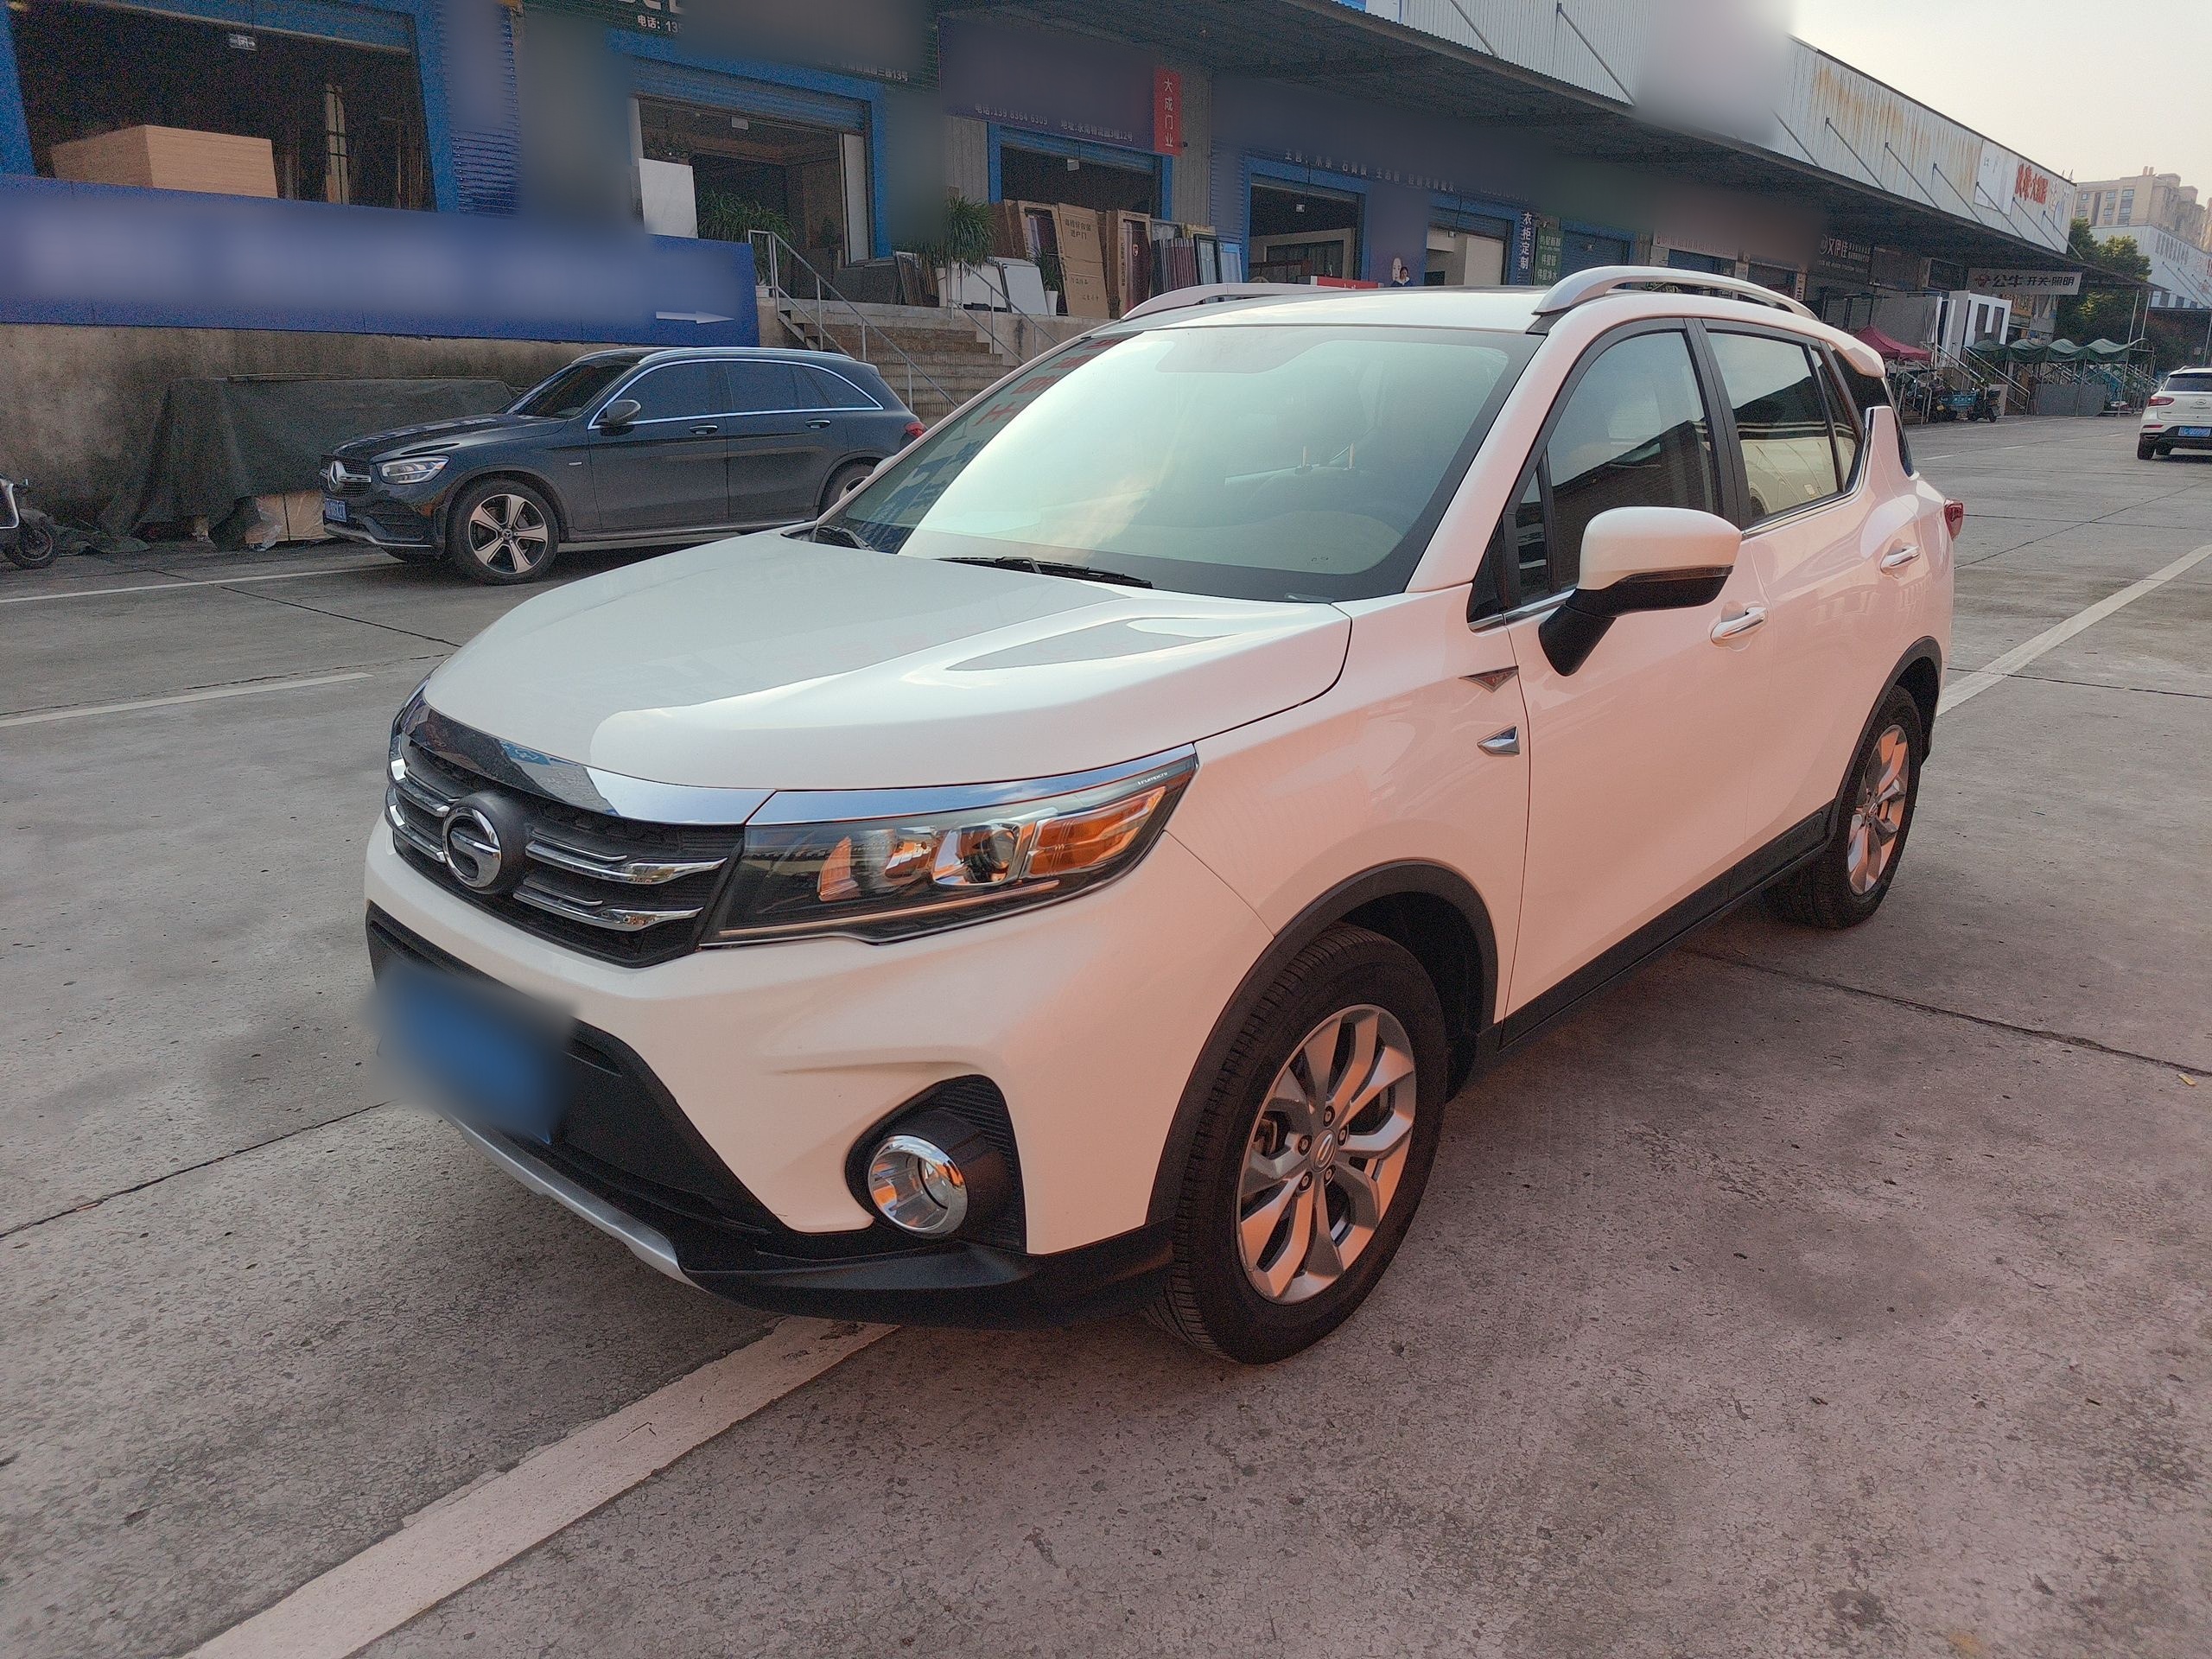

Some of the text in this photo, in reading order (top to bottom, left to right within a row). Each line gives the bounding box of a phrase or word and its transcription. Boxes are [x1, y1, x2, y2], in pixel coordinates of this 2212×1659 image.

[1164, 78, 1173, 148] 大成门业
[1521, 212, 1533, 270] 衣柜定制
[1993, 274, 2023, 288] 公牛
